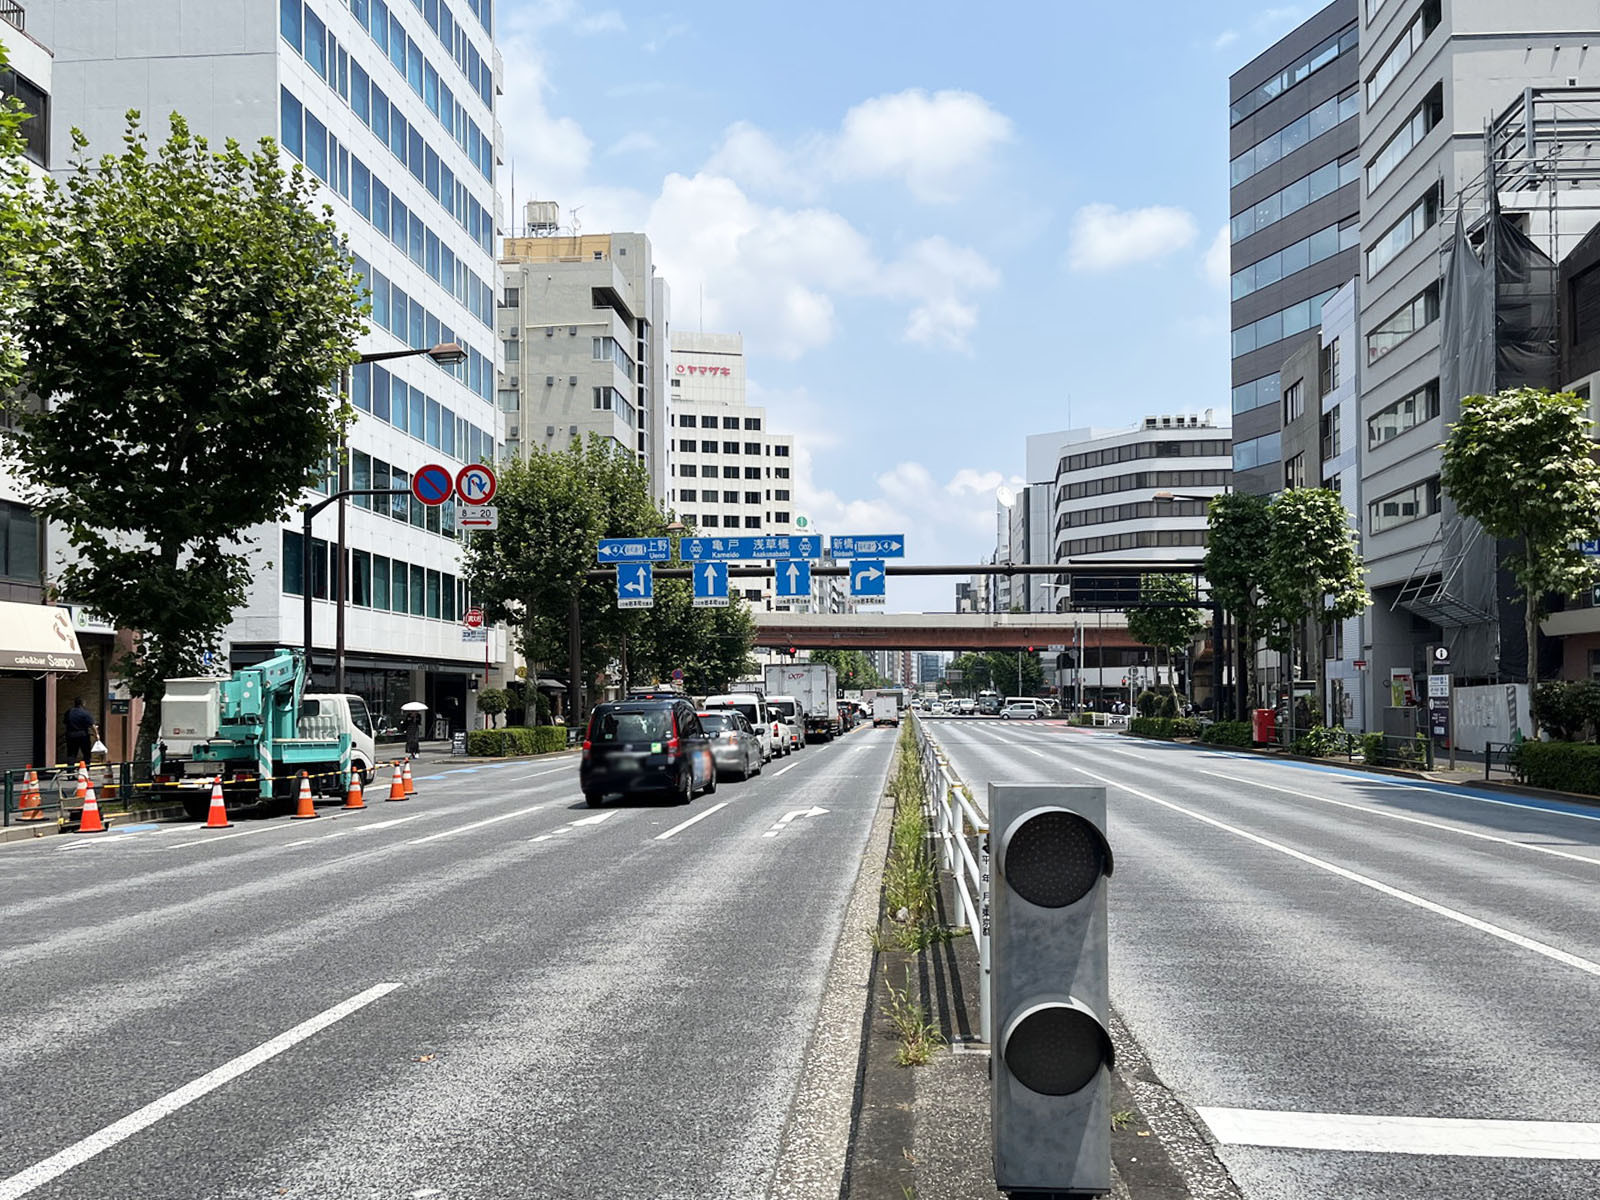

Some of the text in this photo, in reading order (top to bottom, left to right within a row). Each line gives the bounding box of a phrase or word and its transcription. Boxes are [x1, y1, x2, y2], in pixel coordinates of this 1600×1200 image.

[687, 366, 731, 376] ヤマザキ
[461, 509, 468, 517] 8
[480, 509, 492, 517] 20
[647, 540, 668, 552] 上野
[712, 539, 740, 551] 亀戸
[753, 538, 790, 551] 浅草橋
[833, 538, 854, 550] 新橋
[14, 654, 76, 669] cafe&bar Sampo
